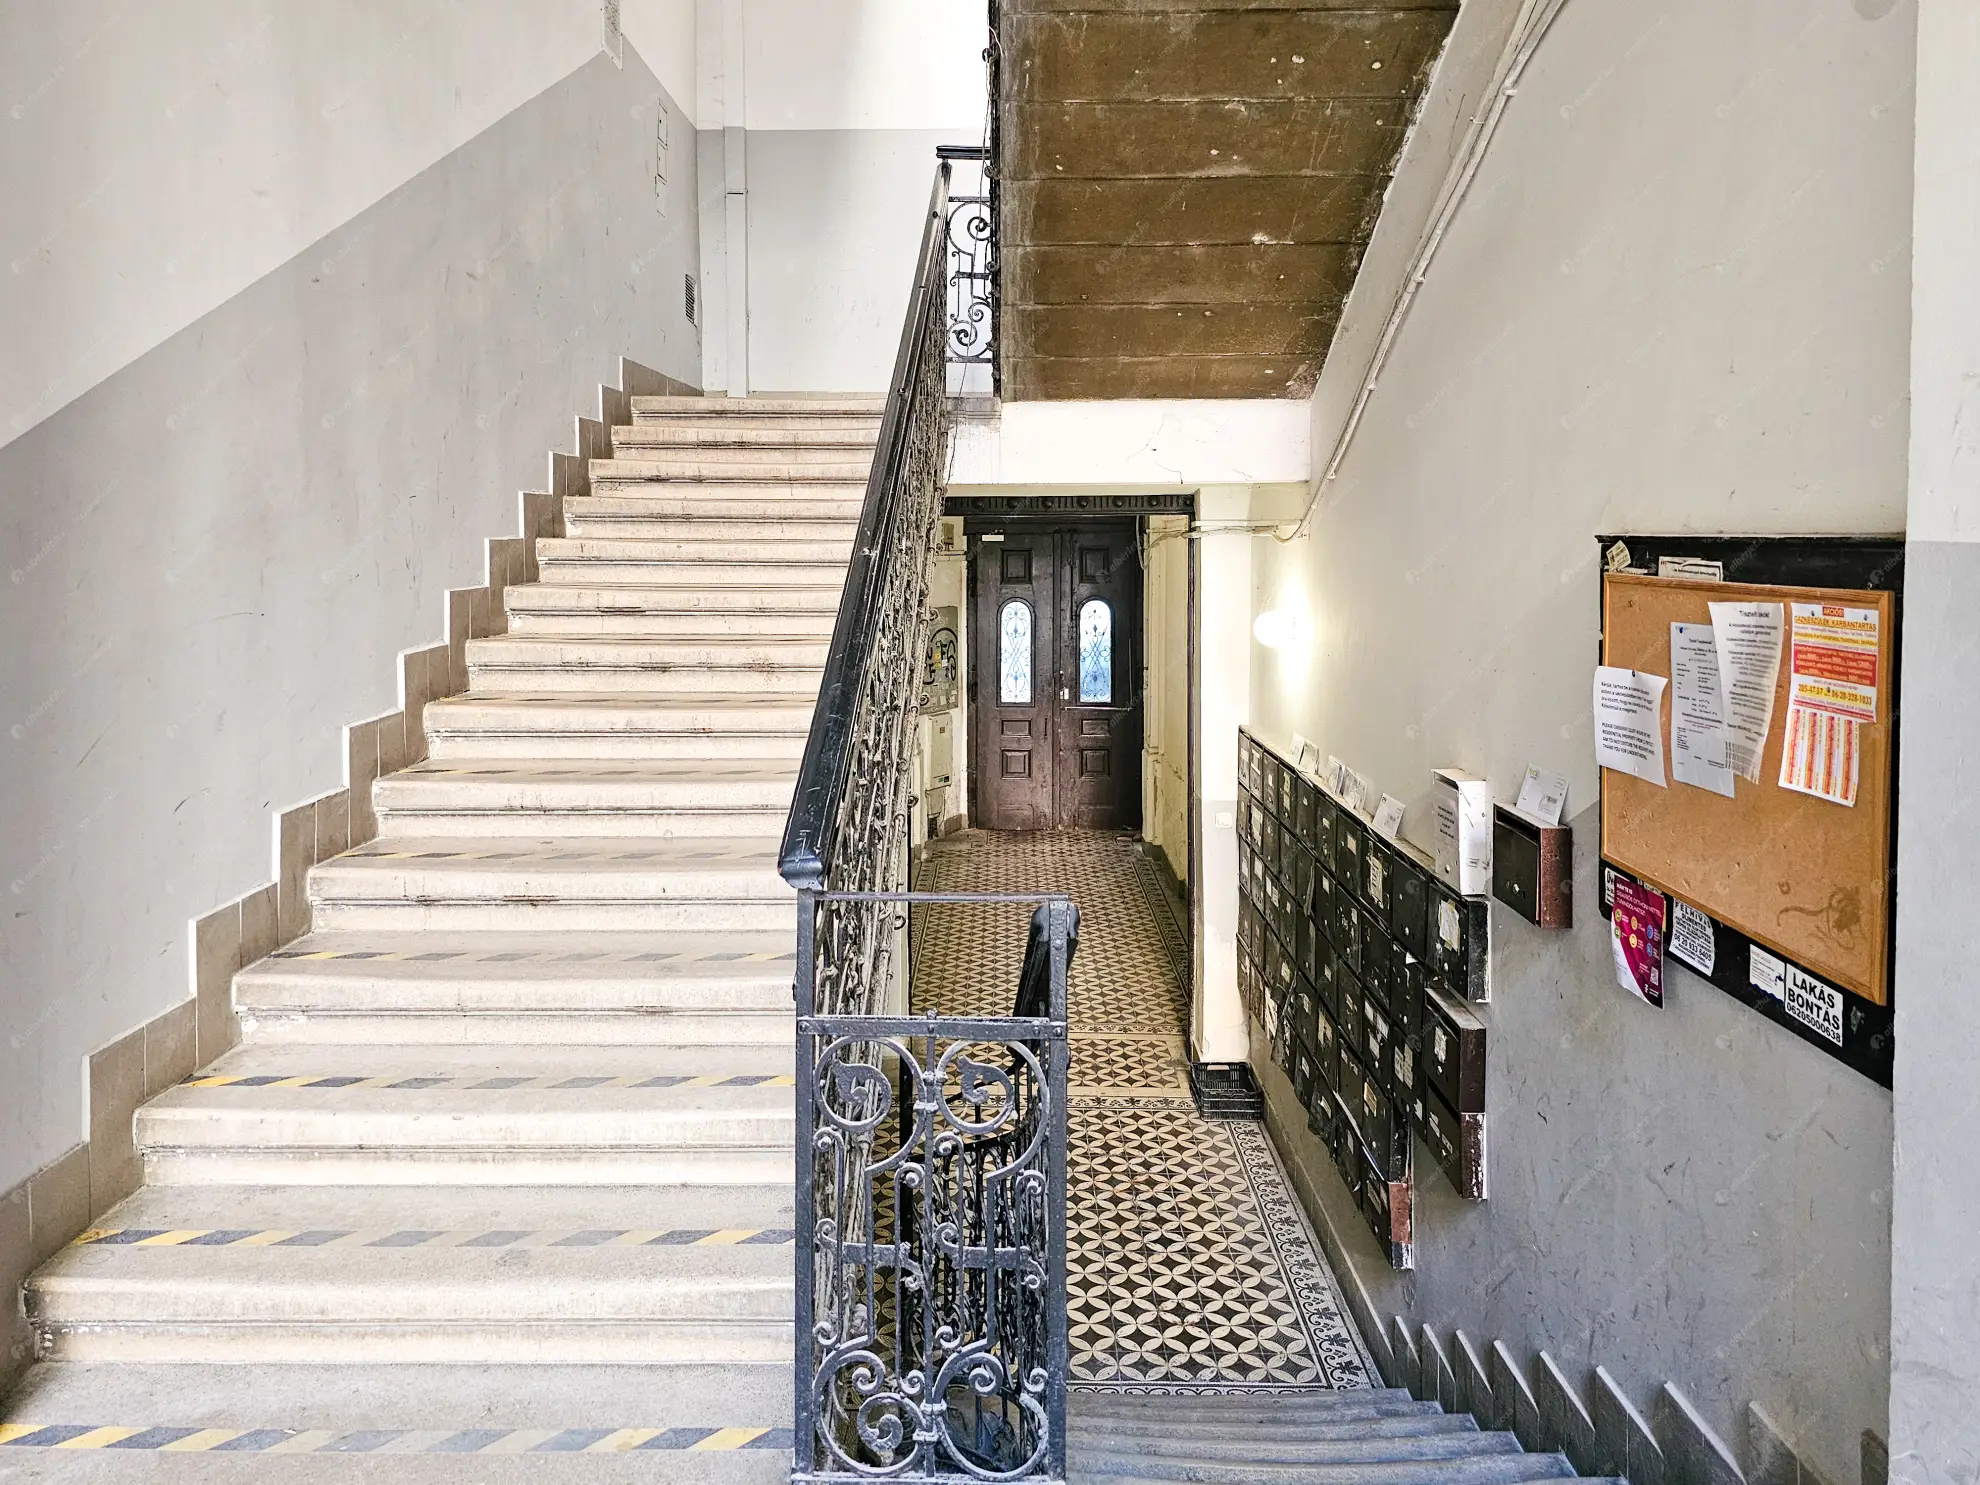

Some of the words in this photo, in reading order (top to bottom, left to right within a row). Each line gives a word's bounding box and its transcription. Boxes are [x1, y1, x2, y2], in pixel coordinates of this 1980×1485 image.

[1788, 988, 1839, 1030] BONTÁS
[1793, 972, 1834, 1008] LAKÁS
[1787, 1003, 1841, 1043] 06205000638
